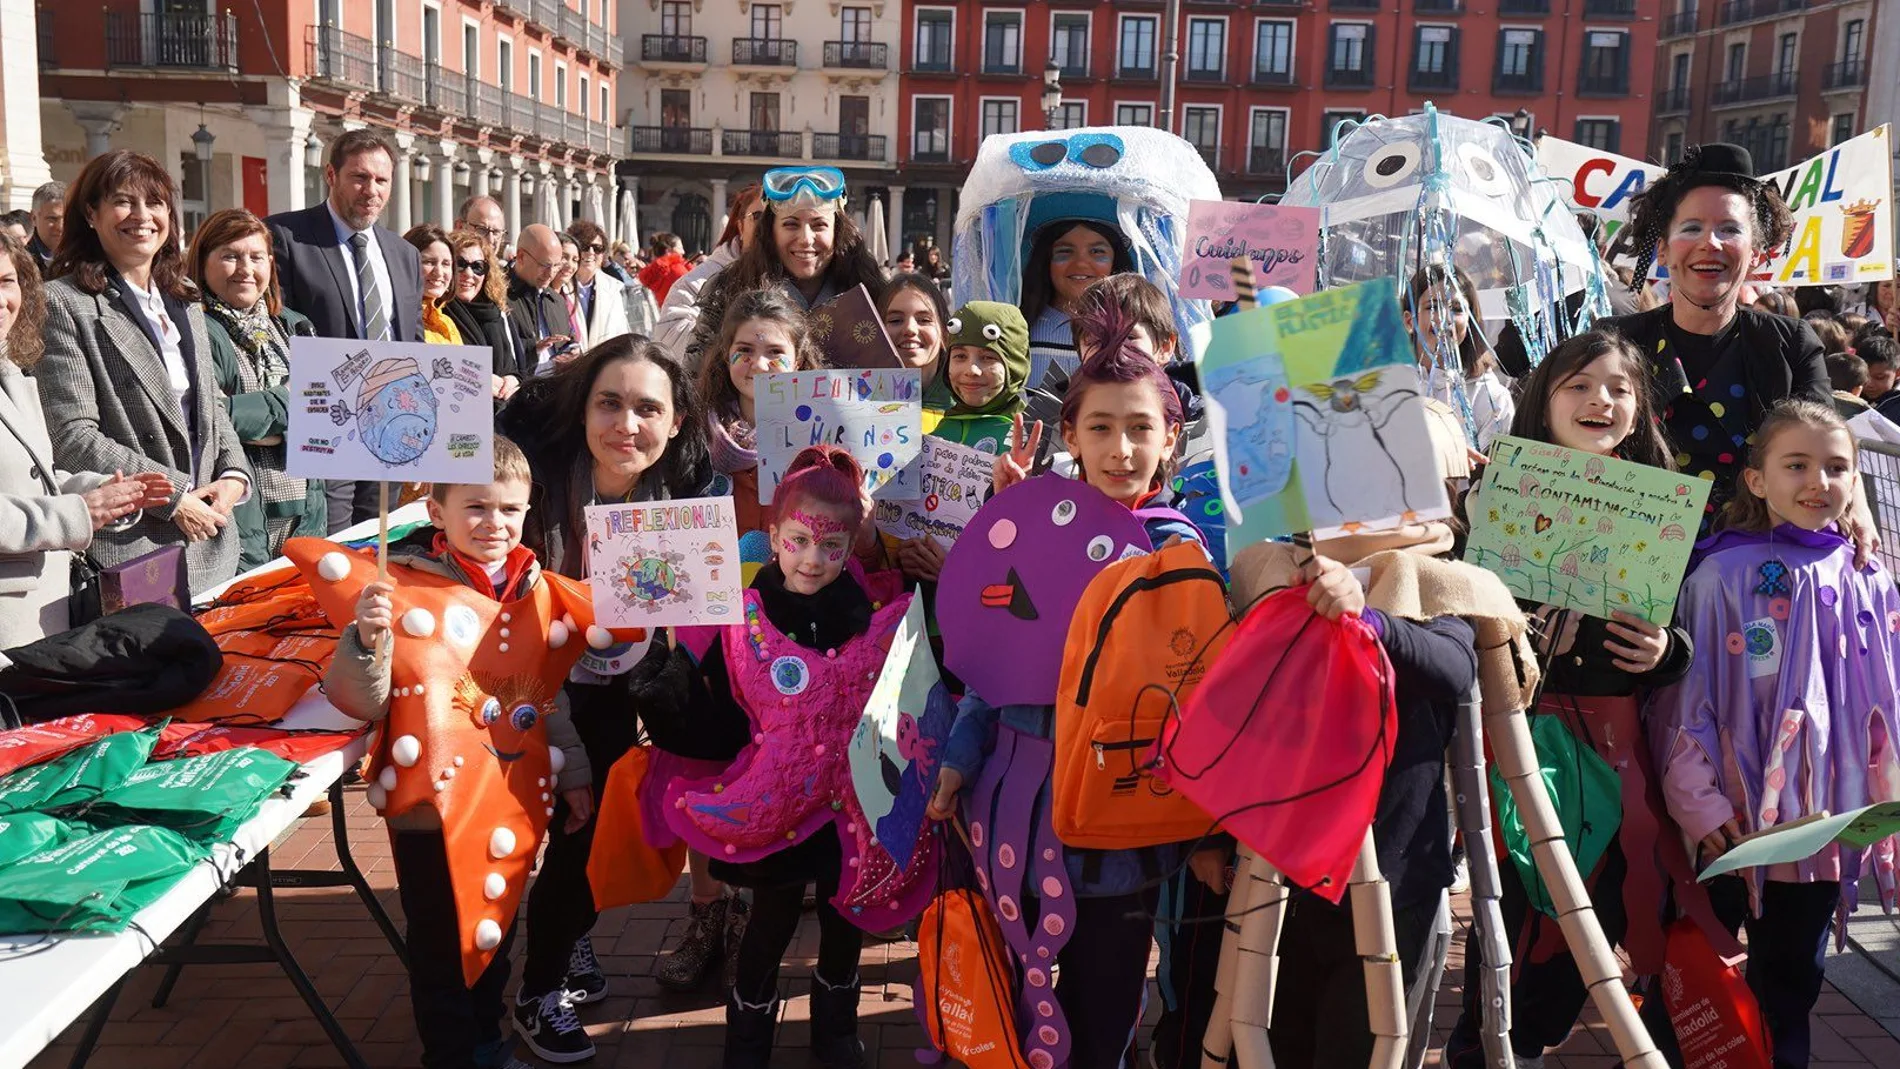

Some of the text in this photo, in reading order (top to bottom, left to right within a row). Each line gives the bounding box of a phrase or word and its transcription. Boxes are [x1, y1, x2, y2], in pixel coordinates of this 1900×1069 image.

[811, 370, 921, 402] CUIDAMOS
[809, 421, 846, 446] MAR
[863, 423, 910, 448] NOS
[604, 504, 722, 540] ¡REFLEXIONA!
[1726, 1034, 1747, 1049] coles
